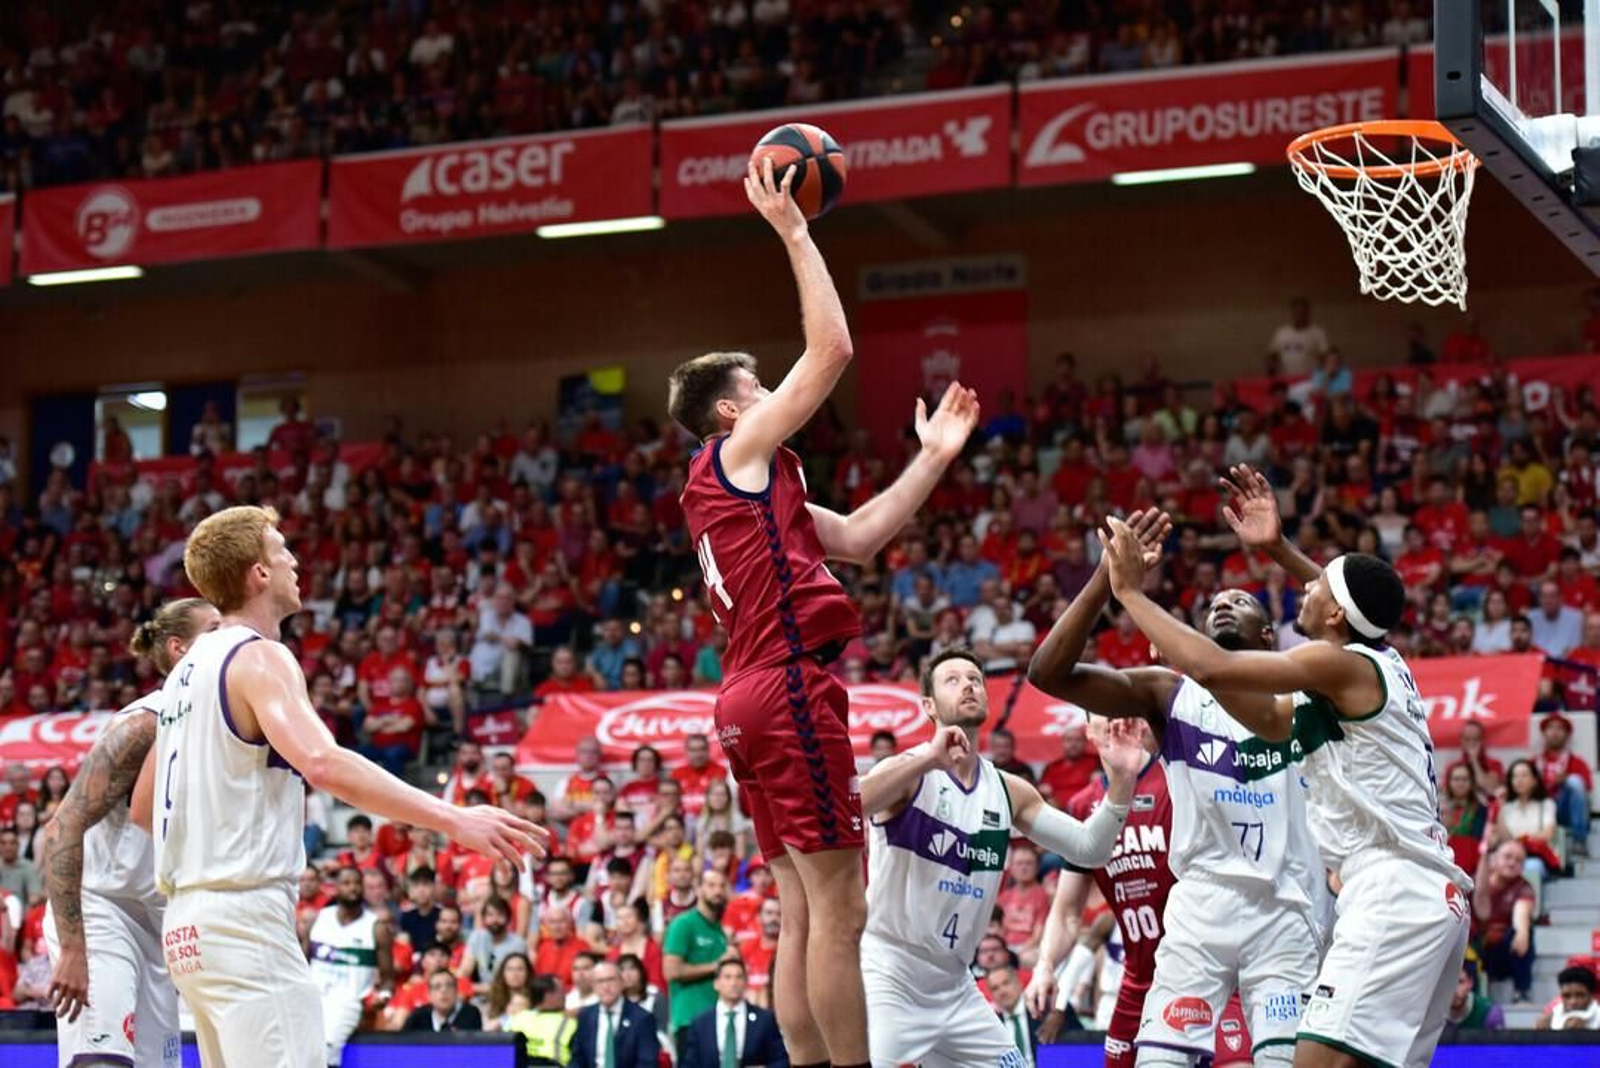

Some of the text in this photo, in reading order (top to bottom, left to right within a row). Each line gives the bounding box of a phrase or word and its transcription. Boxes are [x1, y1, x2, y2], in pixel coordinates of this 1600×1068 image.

[1085, 87, 1383, 150] GRUPOSURESTE
[435, 141, 575, 195] caser
[401, 198, 575, 235] Grupo Helvetia
[1232, 822, 1263, 862] 77
[1105, 853, 1156, 878] MURCIA
[164, 925, 200, 947] COSTA
[942, 913, 960, 949] 4
[1122, 904, 1161, 943] 00
[178, 945, 202, 960] SOL
